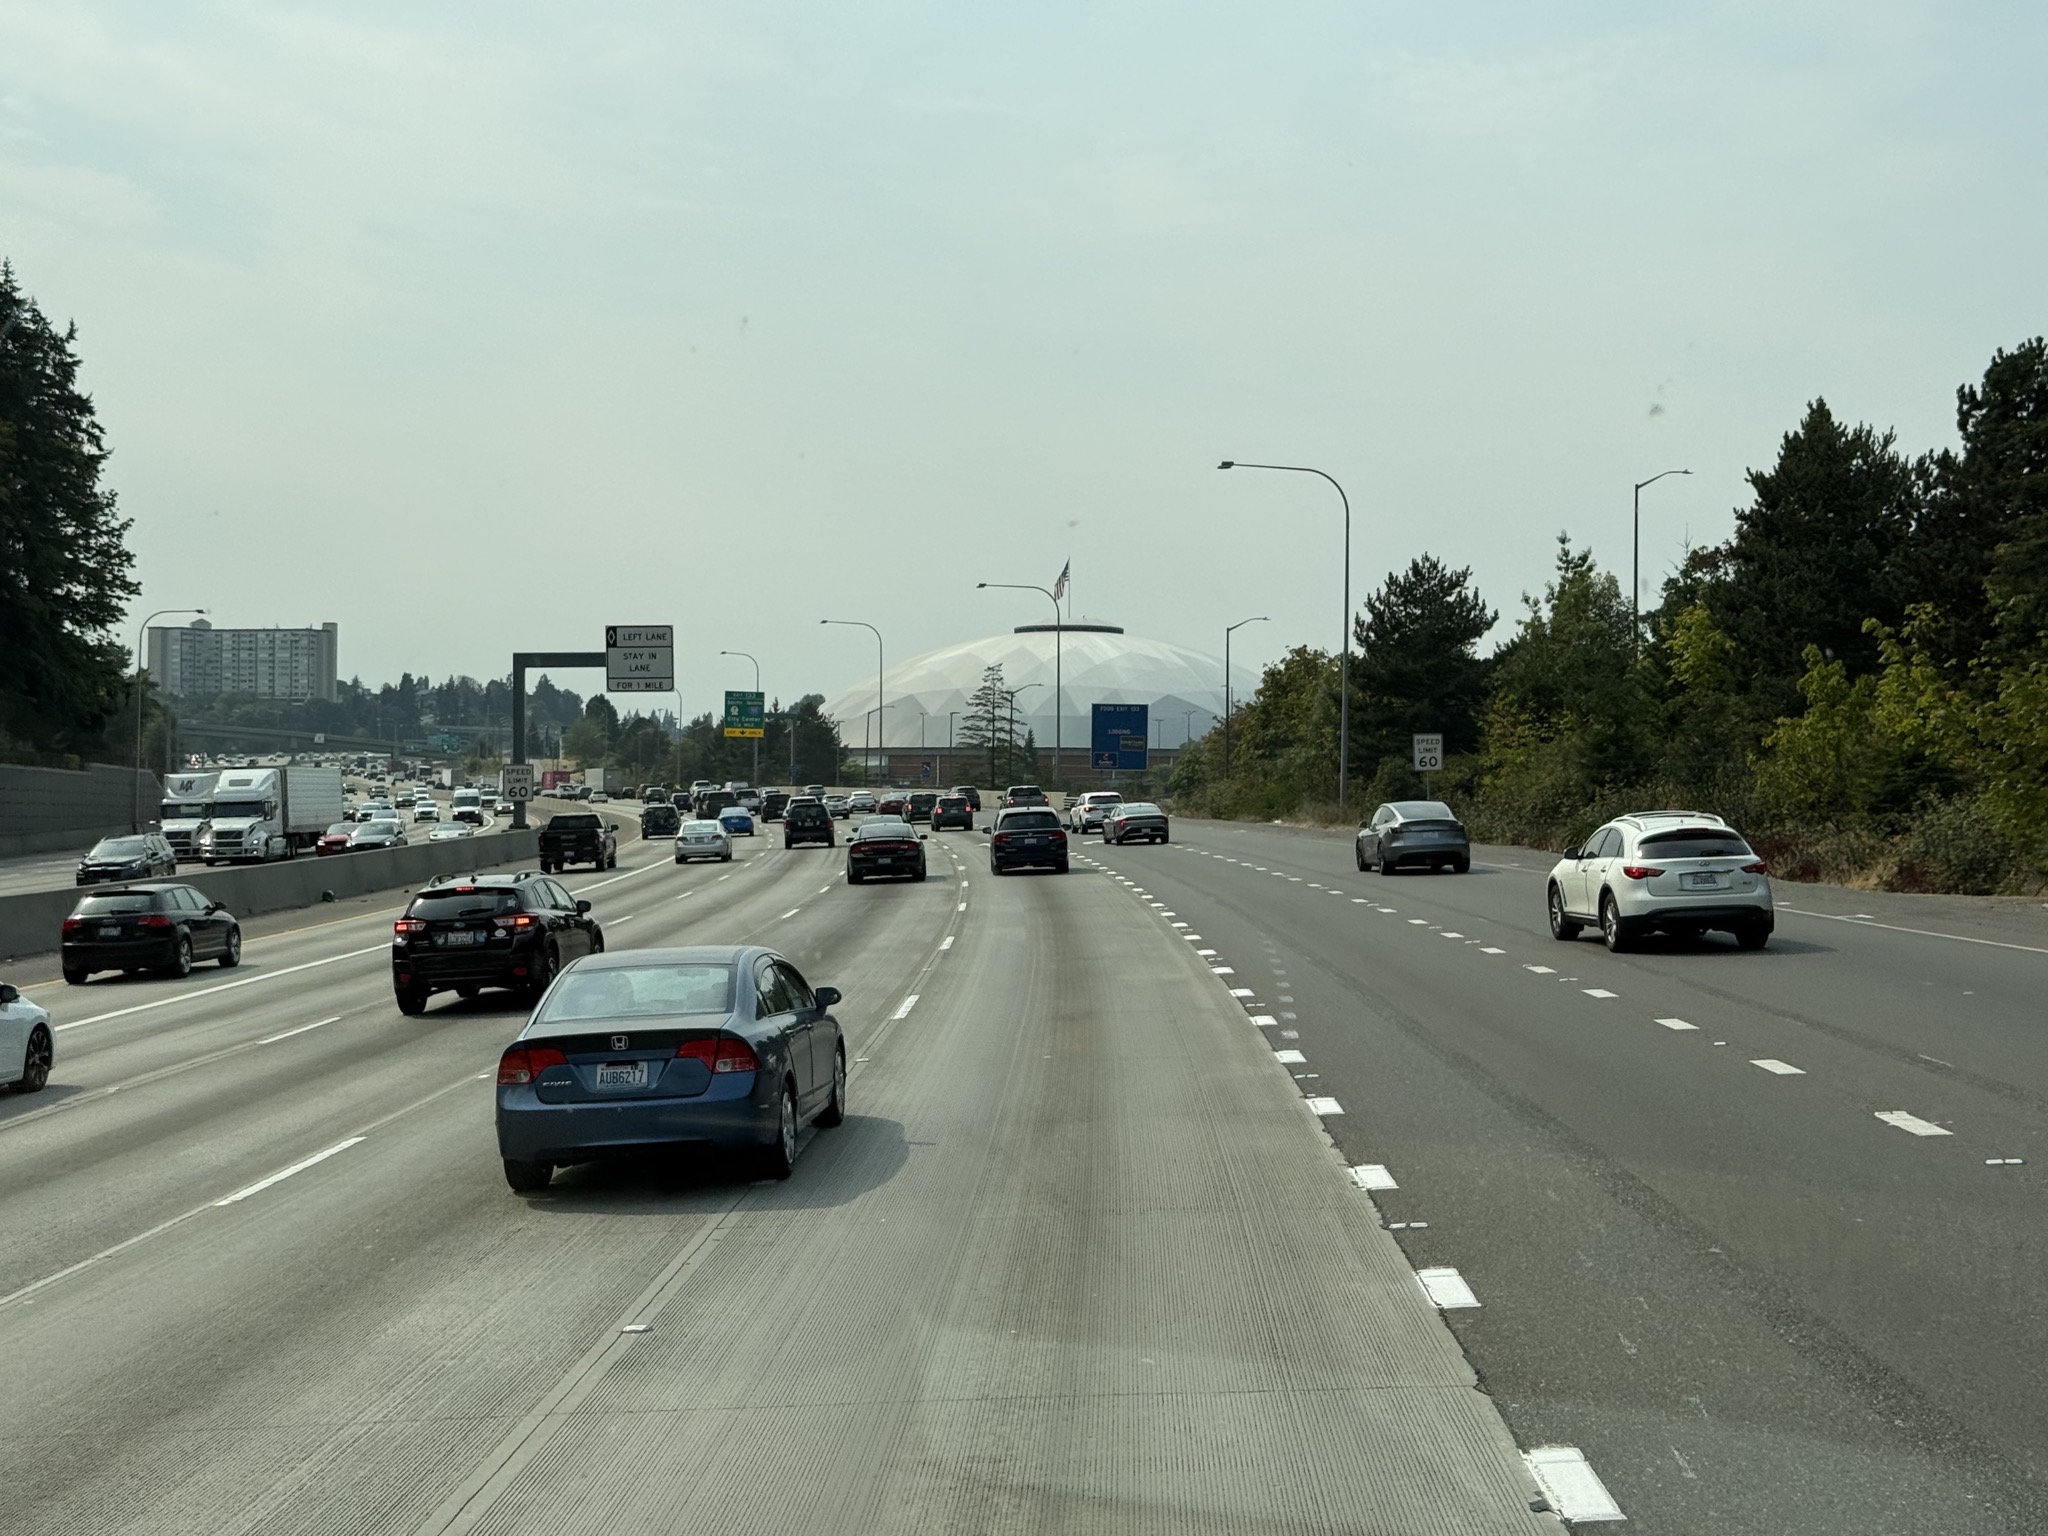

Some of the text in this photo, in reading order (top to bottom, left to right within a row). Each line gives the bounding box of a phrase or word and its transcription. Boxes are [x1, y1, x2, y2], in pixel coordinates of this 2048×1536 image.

[623, 633, 667, 641] LEFT LANE
[630, 664, 651, 672] LANE
[1419, 756, 1438, 767] 60
[508, 786, 528, 798] 60
